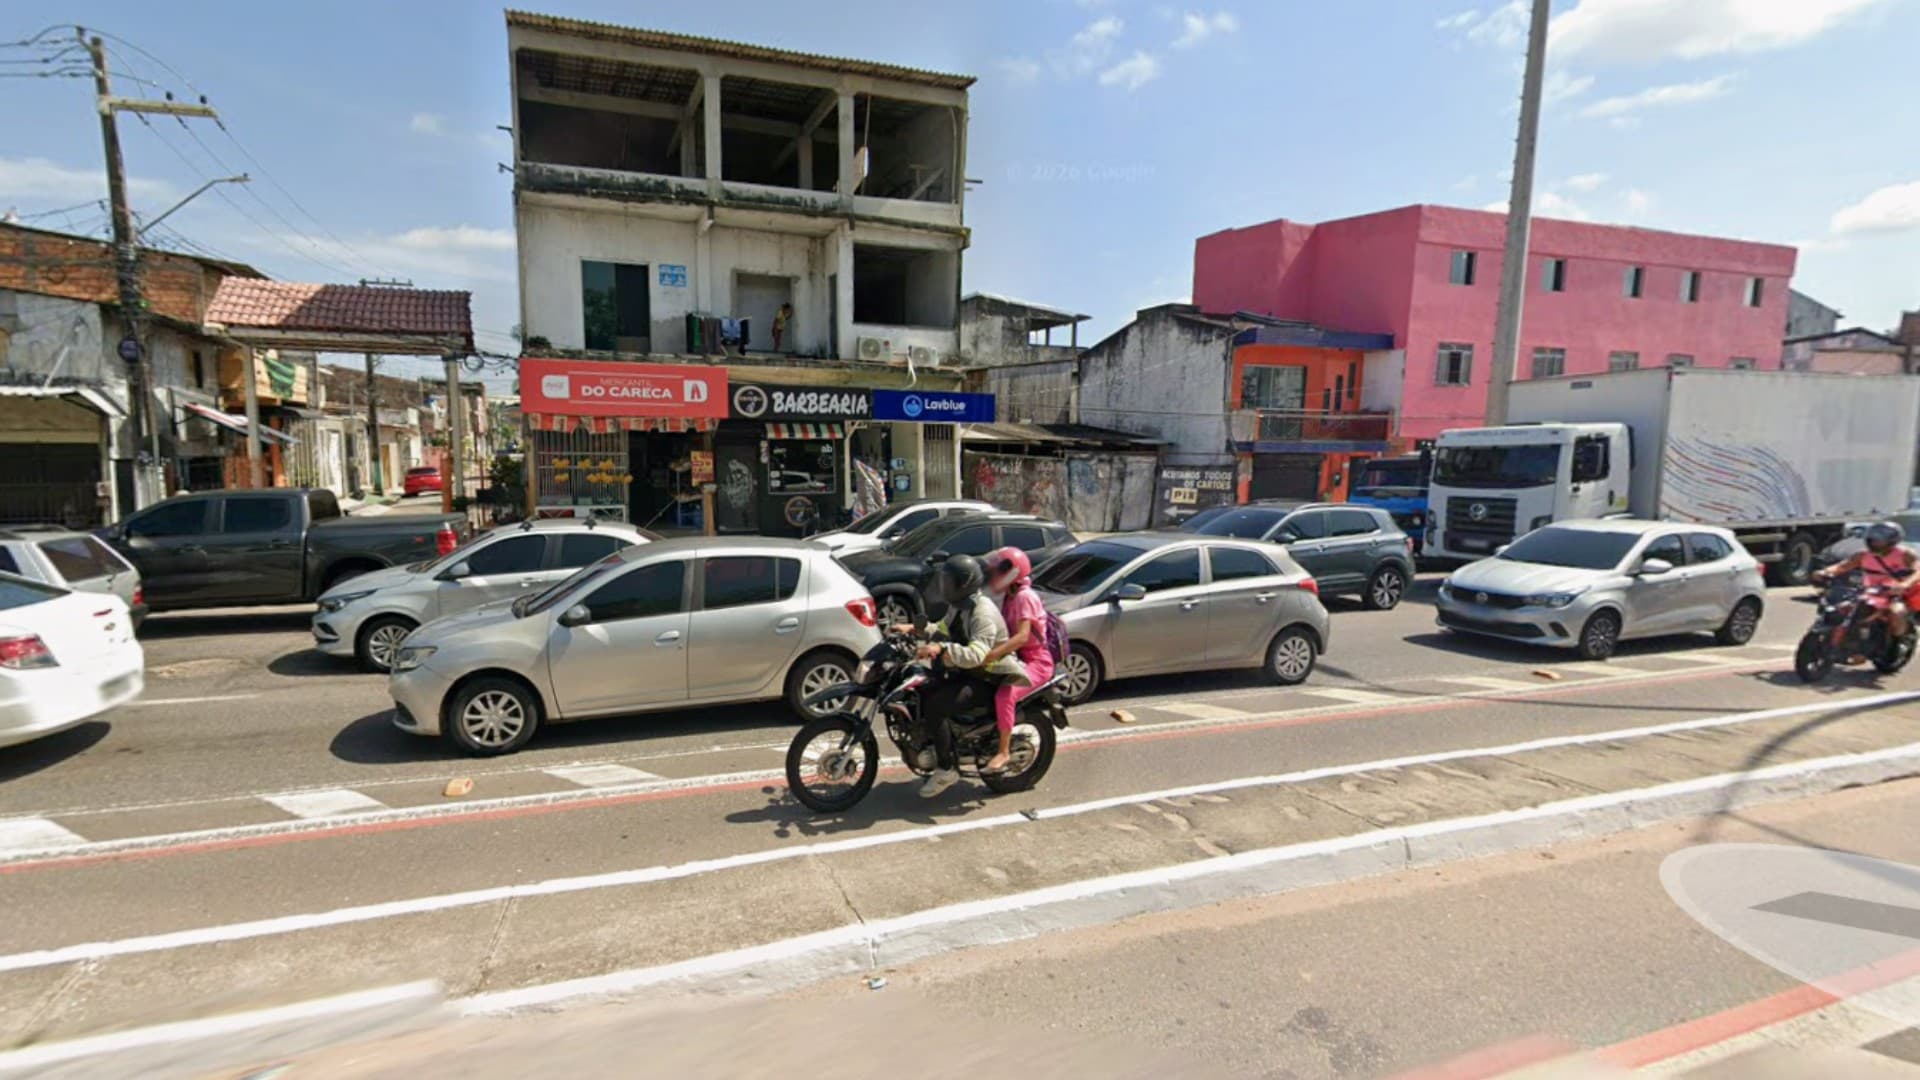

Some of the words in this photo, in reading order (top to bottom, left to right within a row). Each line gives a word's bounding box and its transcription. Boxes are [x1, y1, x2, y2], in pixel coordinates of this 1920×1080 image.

[581, 385, 605, 397] DO
[609, 386, 673, 399] CARECA
[772, 391, 868, 415] BARBEARIA
[924, 399, 966, 410] Lavblue
